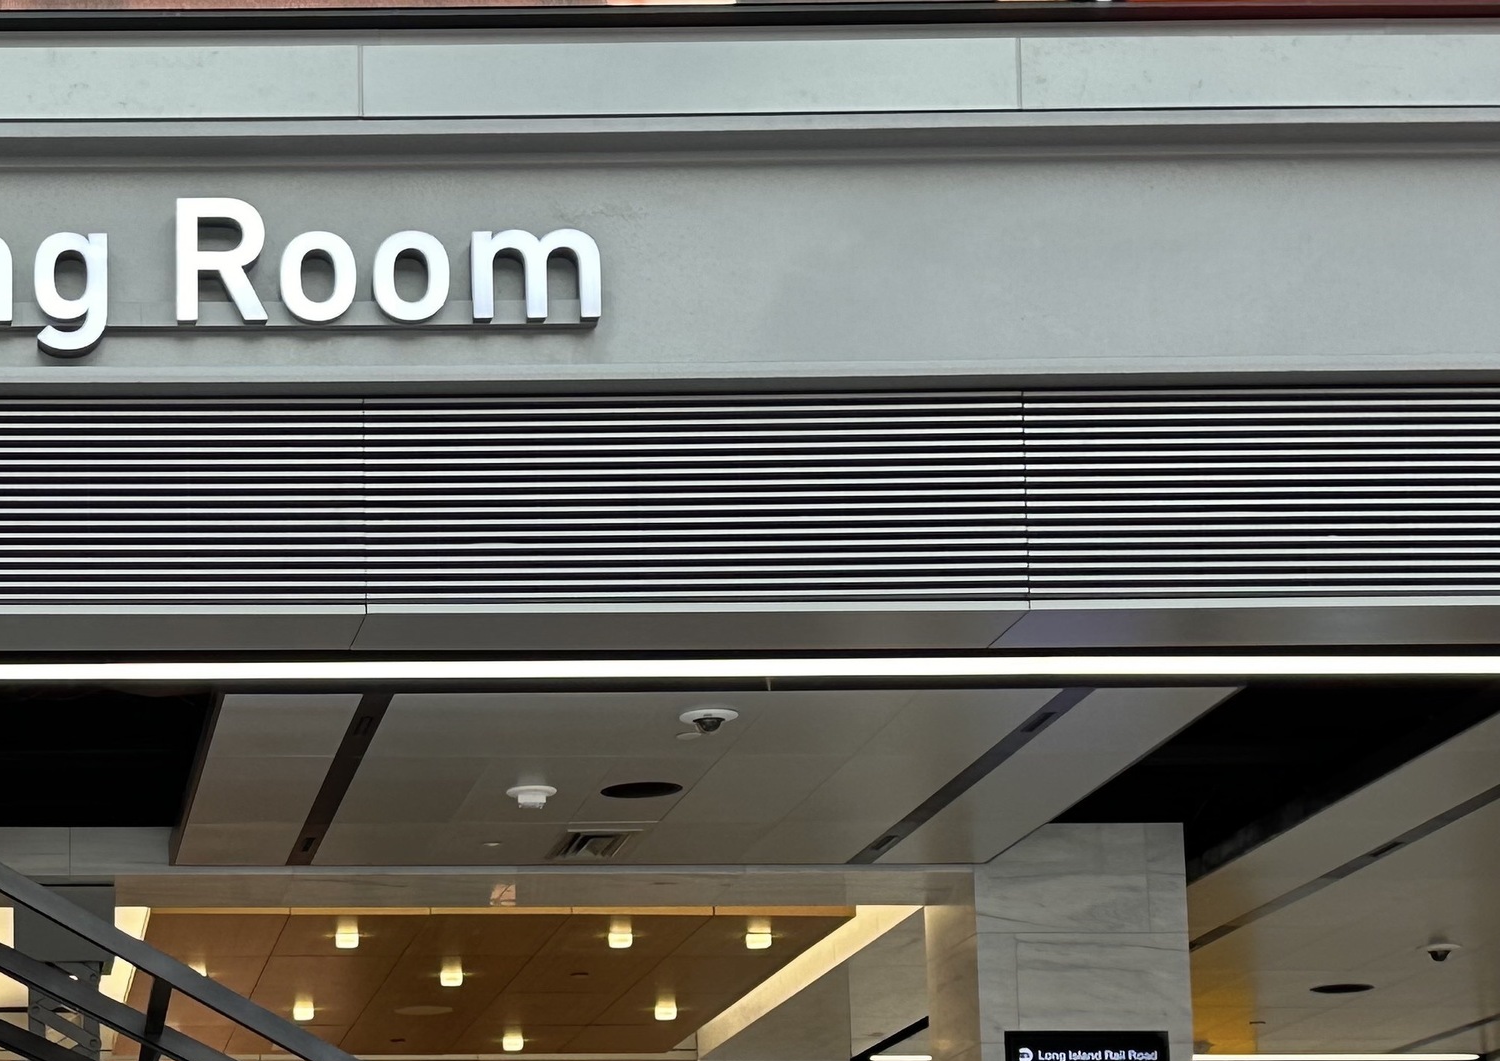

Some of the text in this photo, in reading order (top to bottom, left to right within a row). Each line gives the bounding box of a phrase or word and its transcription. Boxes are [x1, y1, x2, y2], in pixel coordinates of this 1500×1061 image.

[176, 198, 602, 325] Room
[1069, 1050, 1102, 1061] Island
[1104, 1050, 1125, 1061] Rail
[1128, 1050, 1158, 1061] Road
